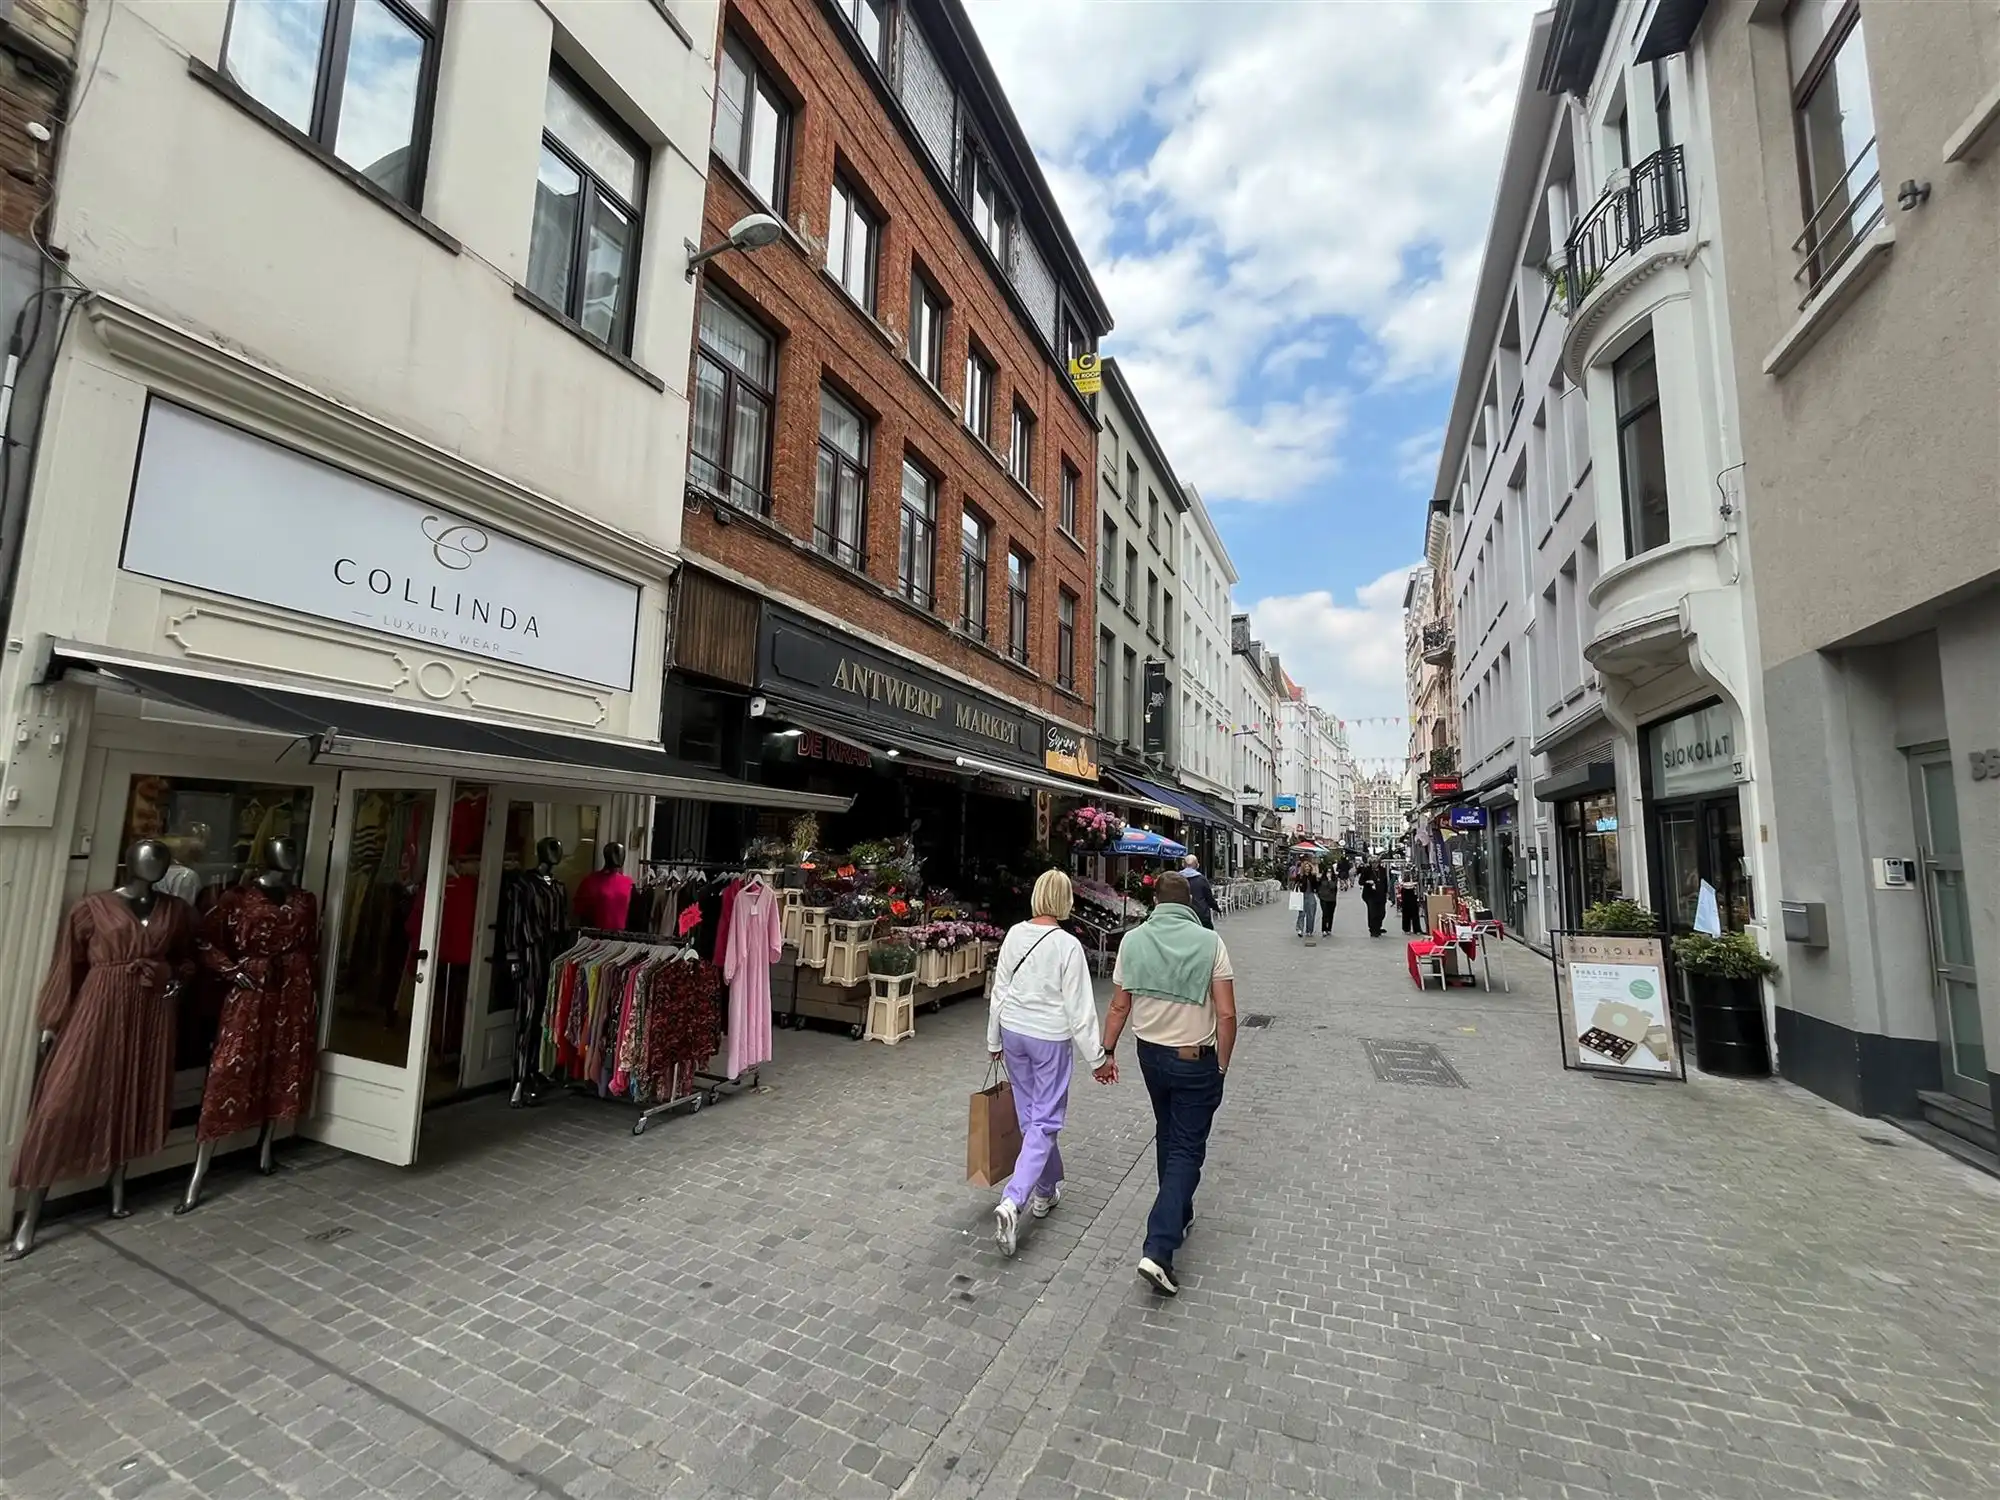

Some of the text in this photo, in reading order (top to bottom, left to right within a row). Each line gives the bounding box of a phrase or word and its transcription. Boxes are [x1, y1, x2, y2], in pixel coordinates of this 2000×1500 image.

[334, 558, 539, 638] COLLINDA
[383, 615, 500, 652] LUXURY WEAR
[832, 658, 1017, 745] ANTWERP MARKET
[798, 732, 823, 758] DE
[1664, 735, 1729, 769] SJOKOLAT
[1570, 945, 1655, 957] SJOKOLAT
